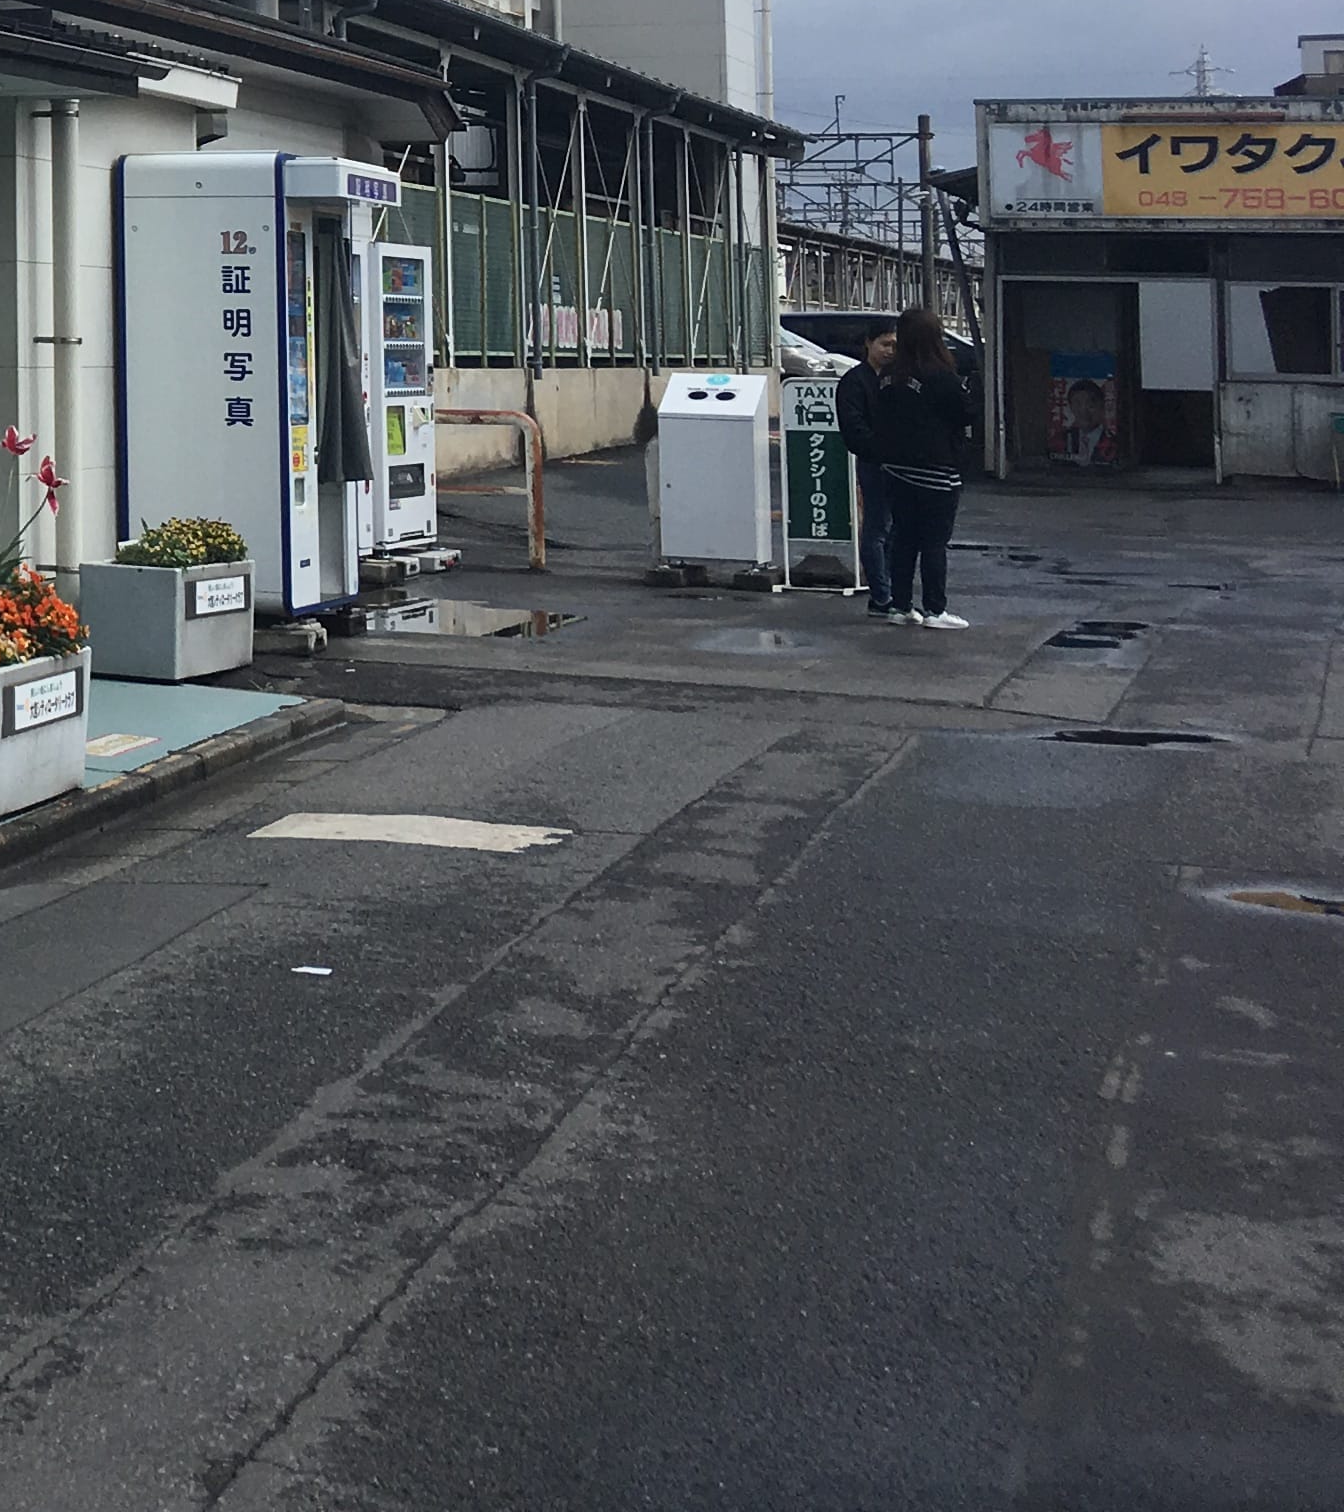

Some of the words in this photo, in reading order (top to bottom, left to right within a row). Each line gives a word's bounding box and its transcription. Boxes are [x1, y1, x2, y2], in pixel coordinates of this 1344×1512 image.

[1115, 133, 1344, 175] イワタク
[221, 265, 254, 427] 証明写真
[795, 387, 834, 398] TAXI
[809, 433, 829, 537] タクシーのりば
